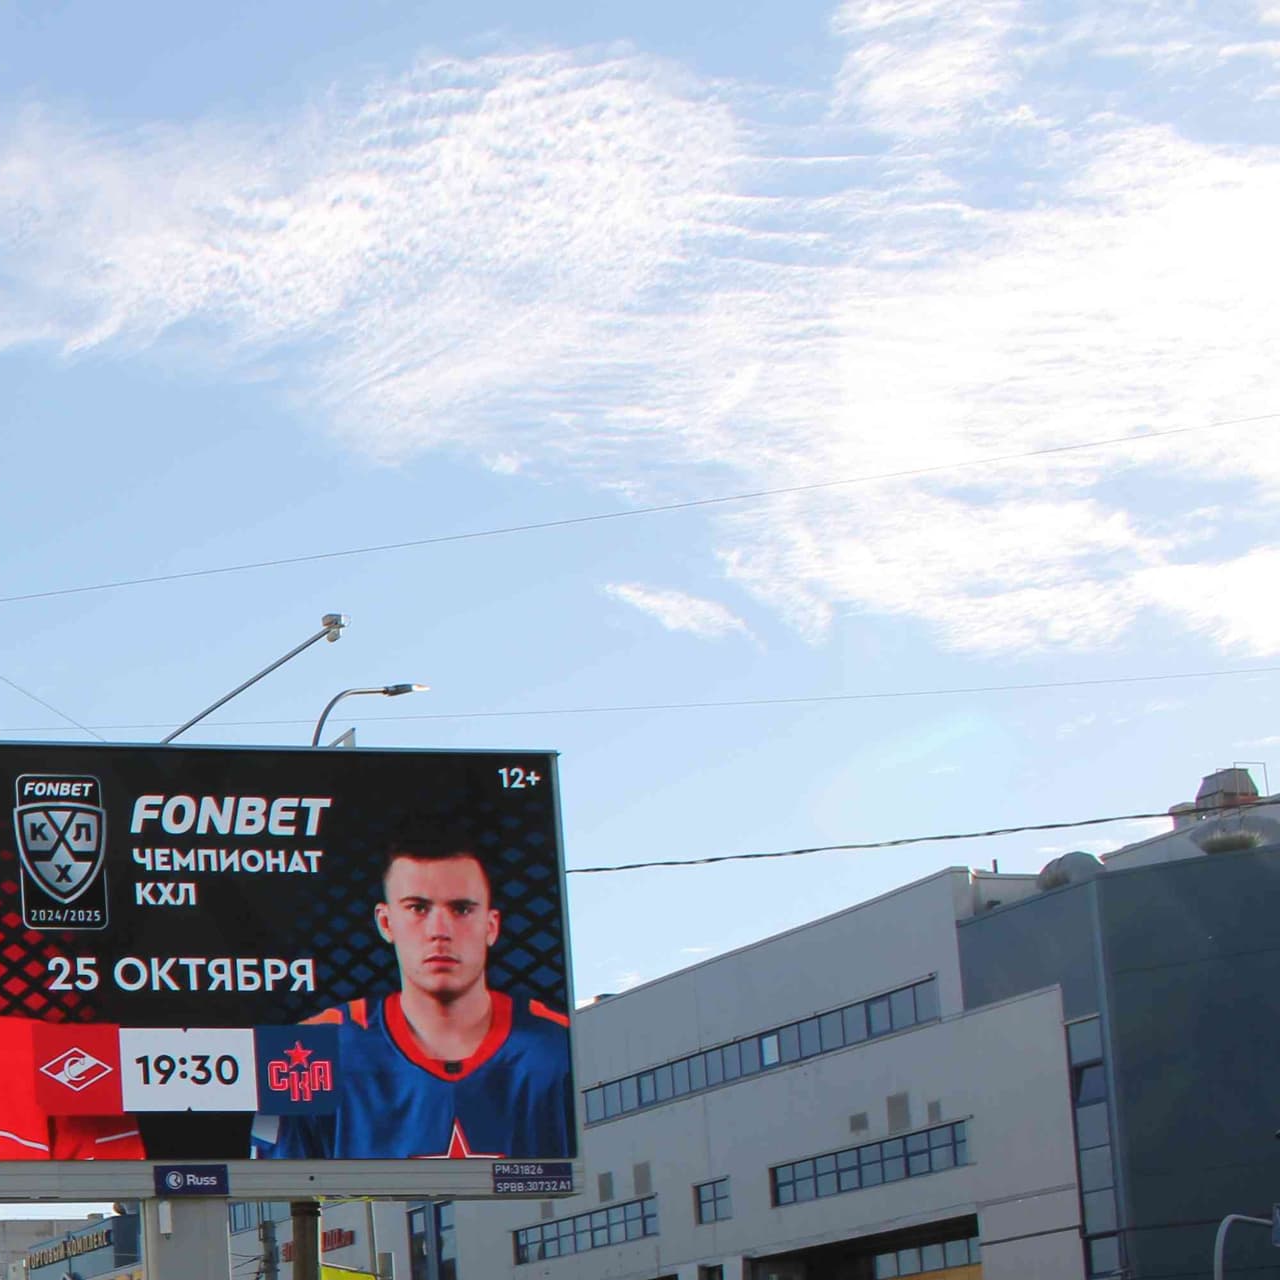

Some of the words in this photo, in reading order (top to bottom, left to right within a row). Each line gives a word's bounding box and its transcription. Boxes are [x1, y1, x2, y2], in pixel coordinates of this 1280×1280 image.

[24, 782, 93, 797] FONBET
[498, 767, 541, 789] 12+
[129, 795, 332, 836] FONBET
[132, 848, 322, 873] ЧЕМПИОНАТ
[135, 882, 197, 905] КХЛ
[31, 909, 101, 922] 2024/2025
[47, 957, 99, 991] 25
[113, 957, 316, 991] ОКТЯБРЯ
[135, 1055, 239, 1086] 19:30
[186, 1174, 217, 1186] Russ
